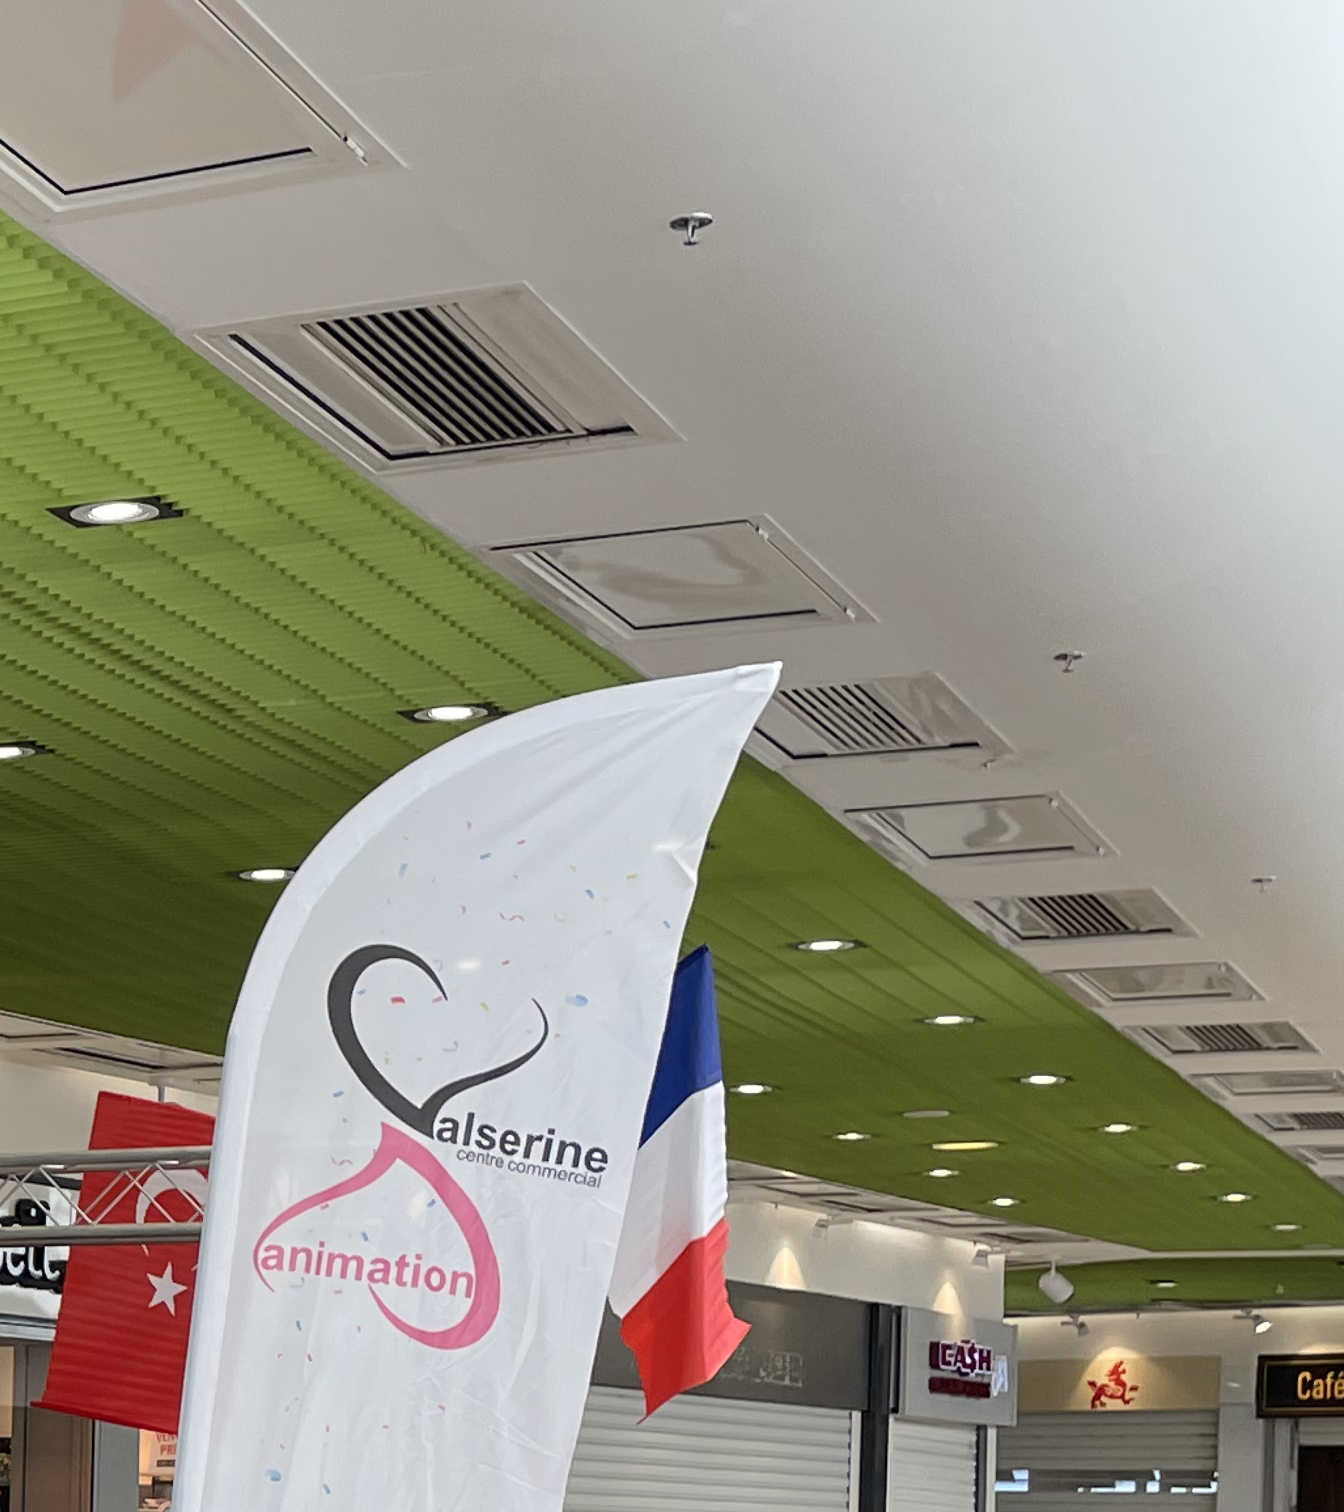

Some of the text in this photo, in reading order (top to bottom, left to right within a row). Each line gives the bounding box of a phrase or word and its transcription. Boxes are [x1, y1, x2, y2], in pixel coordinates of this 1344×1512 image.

[455, 1148, 603, 1190] centre commercial
[261, 1240, 475, 1299] animation
